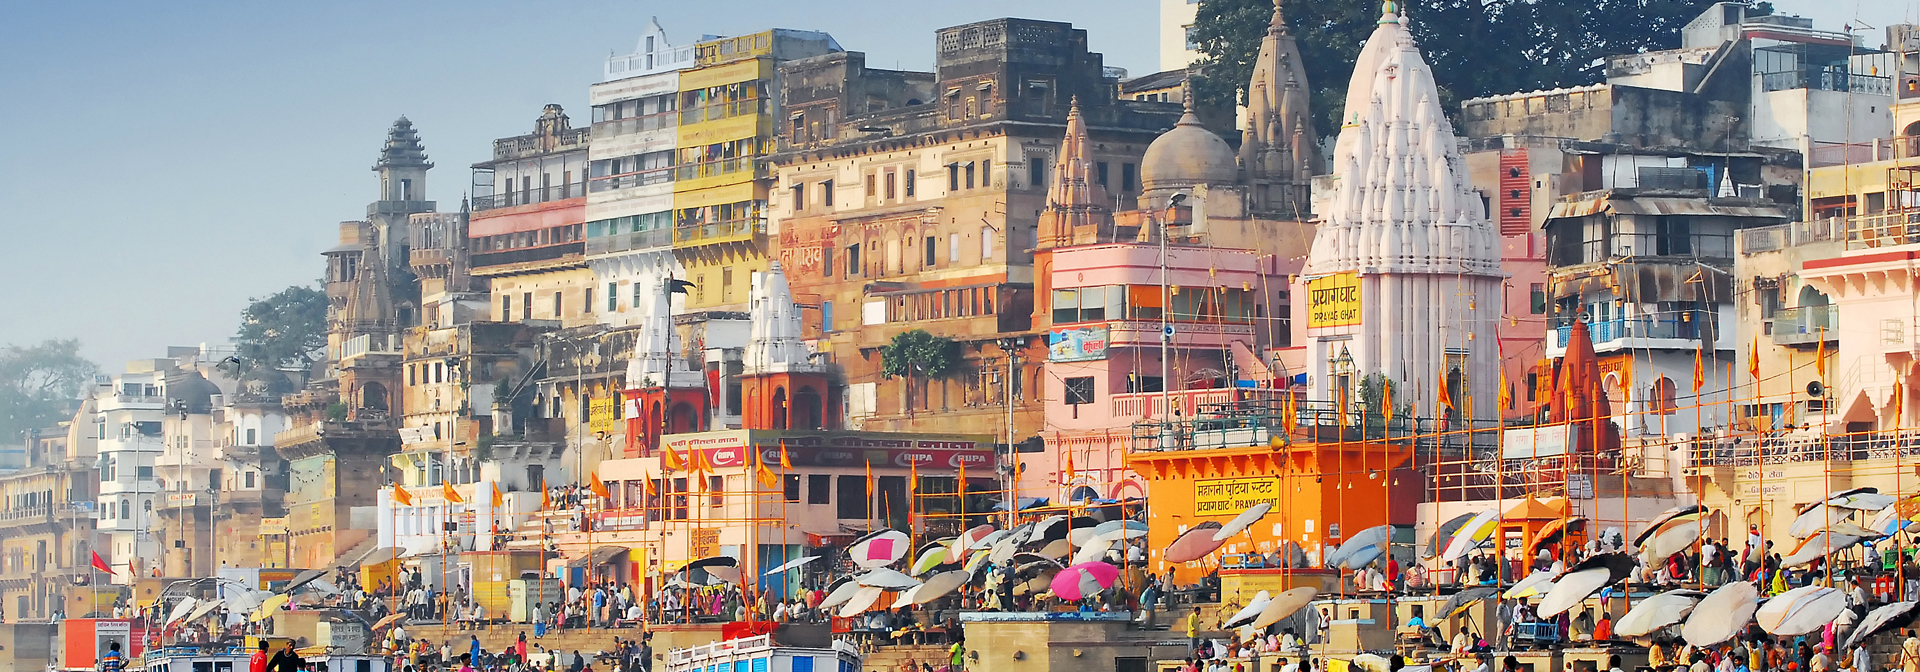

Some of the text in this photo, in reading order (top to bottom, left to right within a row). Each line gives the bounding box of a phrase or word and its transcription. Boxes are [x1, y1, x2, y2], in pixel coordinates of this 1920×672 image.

[1314, 309, 1357, 322] PRAYAG GHAT
[717, 451, 735, 459] RUPA
[903, 454, 933, 462] RUPA
[957, 455, 986, 463] RUPA
[1751, 486, 1771, 494] Gaga
[1197, 500, 1230, 512] प्रयाग घाट
[1235, 499, 1261, 510] PRAYAG
